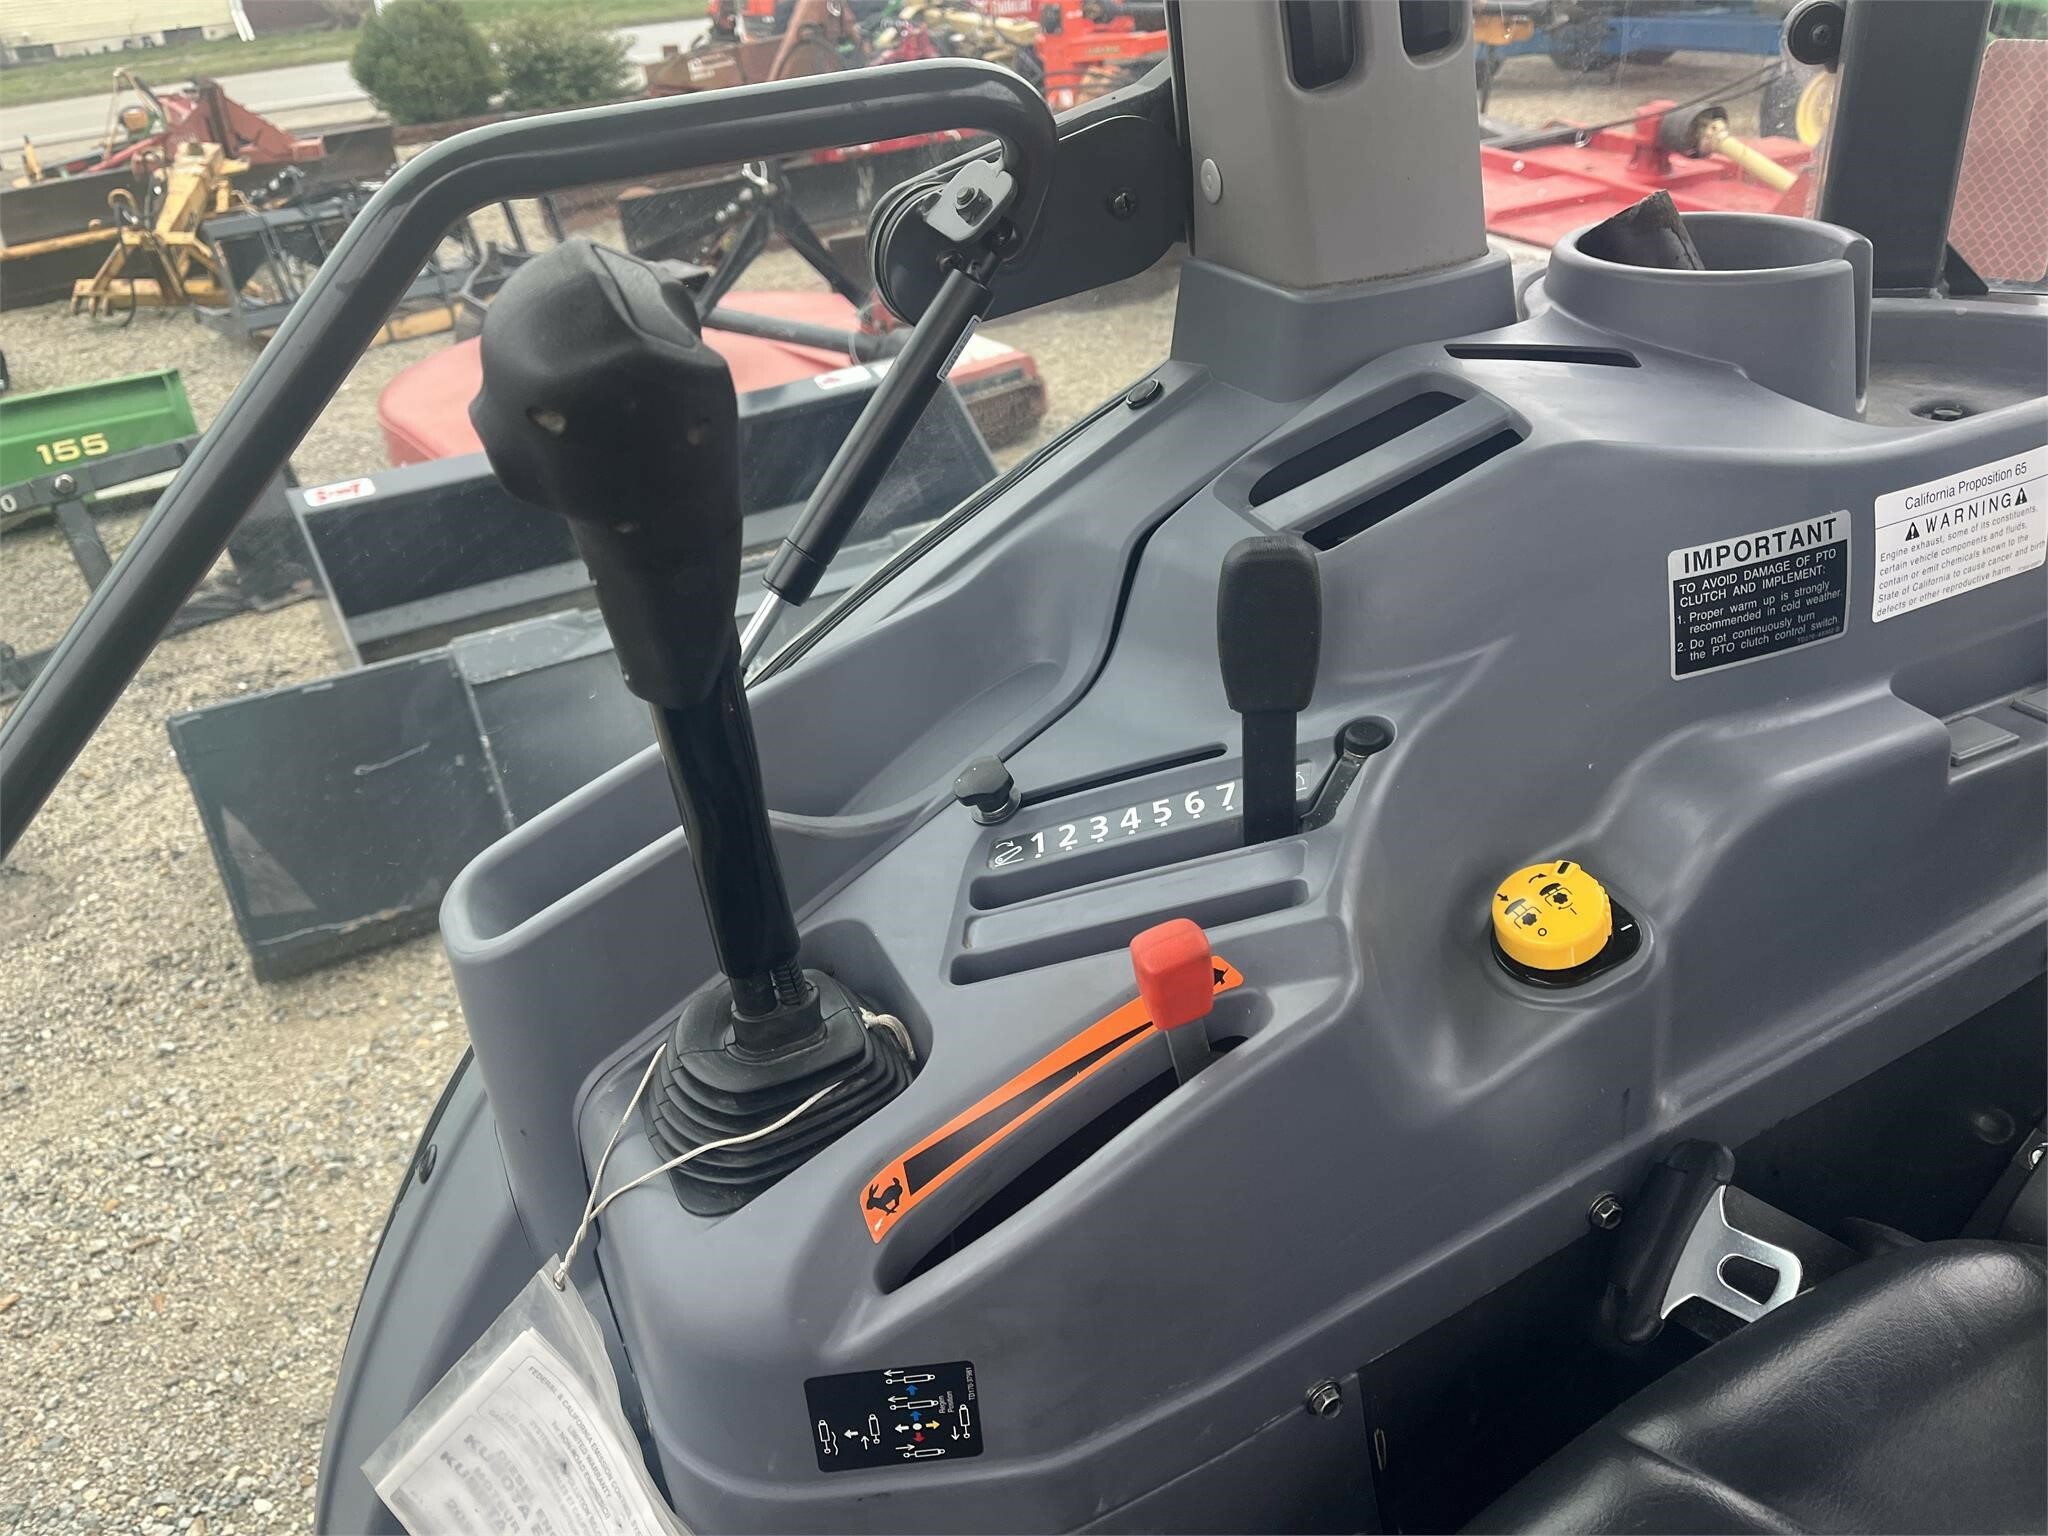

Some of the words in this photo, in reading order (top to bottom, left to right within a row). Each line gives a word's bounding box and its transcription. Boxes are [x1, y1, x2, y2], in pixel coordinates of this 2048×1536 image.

[36, 432, 109, 465] 155
[1905, 487, 1955, 510] California
[1958, 468, 2012, 494] Proposition
[2015, 462, 2026, 475] 65
[1926, 493, 2011, 533] WARNING
[1684, 518, 1836, 573] IMPORTANT
[1879, 573, 1908, 589] contain
[1911, 570, 1919, 579] or
[1922, 561, 1939, 576] emit
[1942, 547, 1979, 568] chemicals
[1982, 541, 2006, 554] known
[2008, 537, 2015, 547] to
[2018, 533, 2028, 543] the
[1880, 560, 1907, 576] certain
[1910, 550, 1938, 566] vehicle
[1941, 534, 1987, 557] components
[1990, 528, 2003, 539] and
[1881, 547, 1908, 562] Engine
[1948, 529, 1968, 540] some
[1971, 523, 1978, 532] of
[1981, 520, 1989, 530] its
[1680, 582, 1695, 594] TO
[1702, 574, 1737, 590] AVOID
[1744, 561, 1790, 581] DAMAGE
[1796, 555, 1810, 568] OF
[1816, 548, 1836, 563] PTO
[1680, 588, 1726, 607] CLUTCH
[1733, 582, 1756, 596] AND
[1762, 565, 1826, 589] IMPLEMENT:
[1879, 590, 1898, 603] State
[1902, 585, 1910, 594] of
[1913, 573, 1950, 591] California
[1953, 569, 1960, 577] to
[1963, 562, 1985, 575] cause
[1988, 554, 2012, 566] cancer
[2015, 546, 2028, 557] and
[2030, 541, 2045, 552] birth
[1678, 616, 1686, 625] 1.
[1690, 606, 1724, 622] Proper
[1730, 600, 1757, 613] warm
[1763, 595, 1775, 607] up
[1781, 592, 1788, 601] is
[1794, 581, 1830, 597] strongly
[1877, 600, 1906, 617] defects
[1909, 596, 1916, 606] or
[1920, 588, 1940, 602] other
[1943, 571, 1990, 593] reproductive
[1678, 643, 1686, 652] 2.
[1690, 639, 1704, 650] Do
[1711, 634, 1726, 645] not
[1732, 617, 1792, 640] continuously
[1798, 611, 1815, 623] turn
[1690, 610, 1761, 634] recommended
[1767, 604, 1775, 616] in
[1782, 600, 1800, 612] cold
[1690, 649, 1705, 661] the
[1712, 642, 1735, 656] PTO
[1741, 634, 1769, 649] clutch
[1775, 626, 1806, 640] control
[1031, 832, 1045, 853] 1
[1059, 824, 1078, 847] 2
[1090, 817, 1108, 839] 3
[1121, 808, 1141, 830] 4
[1153, 799, 1172, 823] 5
[1185, 791, 1205, 814] 6
[1216, 782, 1236, 806] 7
[561, 1398, 594, 1443] CALIFORNIA
[589, 1442, 614, 1481] EMISSION
[584, 1454, 611, 1498] WARRANTY
